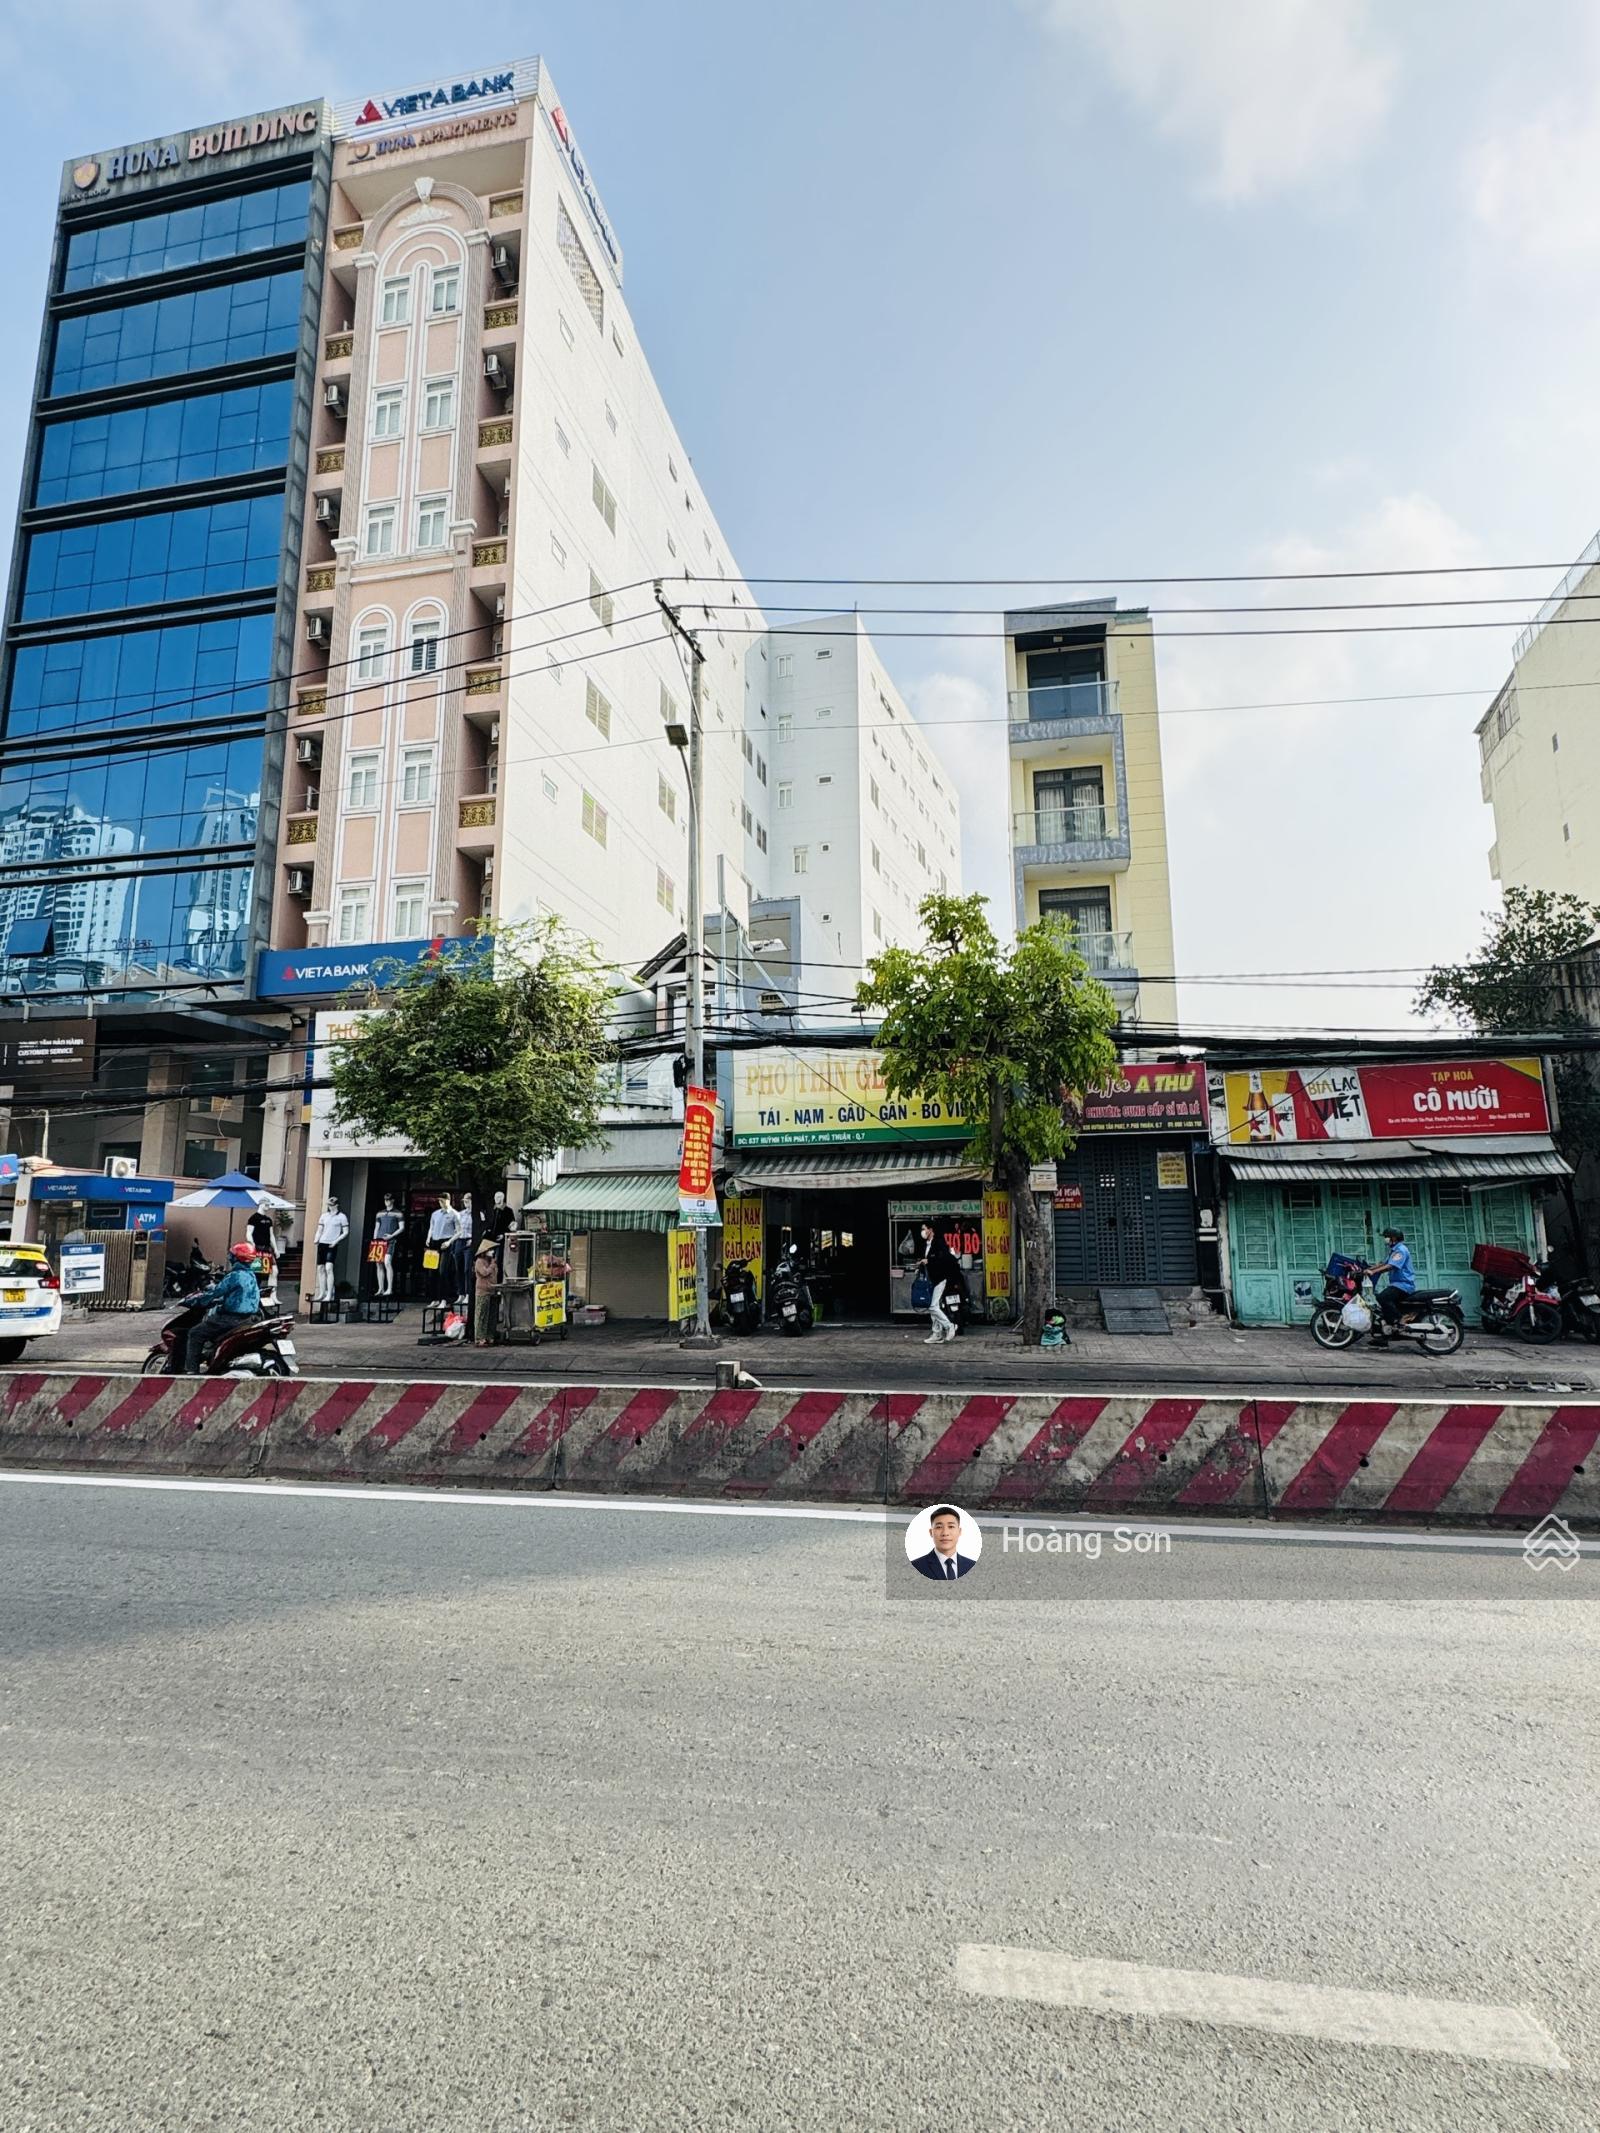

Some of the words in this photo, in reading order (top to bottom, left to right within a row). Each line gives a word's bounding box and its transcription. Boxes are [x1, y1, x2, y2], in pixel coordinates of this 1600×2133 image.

[383, 71, 515, 118] VIETABANK
[107, 143, 180, 182] HUNA
[187, 108, 318, 160] BUILDING
[375, 133, 417, 156] HUNA
[418, 111, 518, 146] APARTMENTS
[295, 963, 370, 980] VIETABANK
[50, 1047, 74, 1055] SERVICE
[1134, 1075, 1151, 1094] A
[1153, 1069, 1196, 1093] THƯ
[1308, 1081, 1333, 1097] BIA
[1331, 1076, 1359, 1093] LẠC
[1431, 1071, 1451, 1085] TẠP
[1453, 1068, 1474, 1081] HOÁ
[1122, 1103, 1146, 1118] CUNG
[1315, 1093, 1361, 1122] VIỆT
[1413, 1088, 1442, 1112] CÔ
[1446, 1084, 1500, 1111] MƯỜI
[759, 1106, 781, 1127] TÁI
[794, 1108, 824, 1128] NẠM
[879, 1100, 908, 1121] GÂN
[922, 1098, 941, 1120] BÒ
[138, 1213, 157, 1223] ATM
[963, 1227, 982, 1255] BÒ
